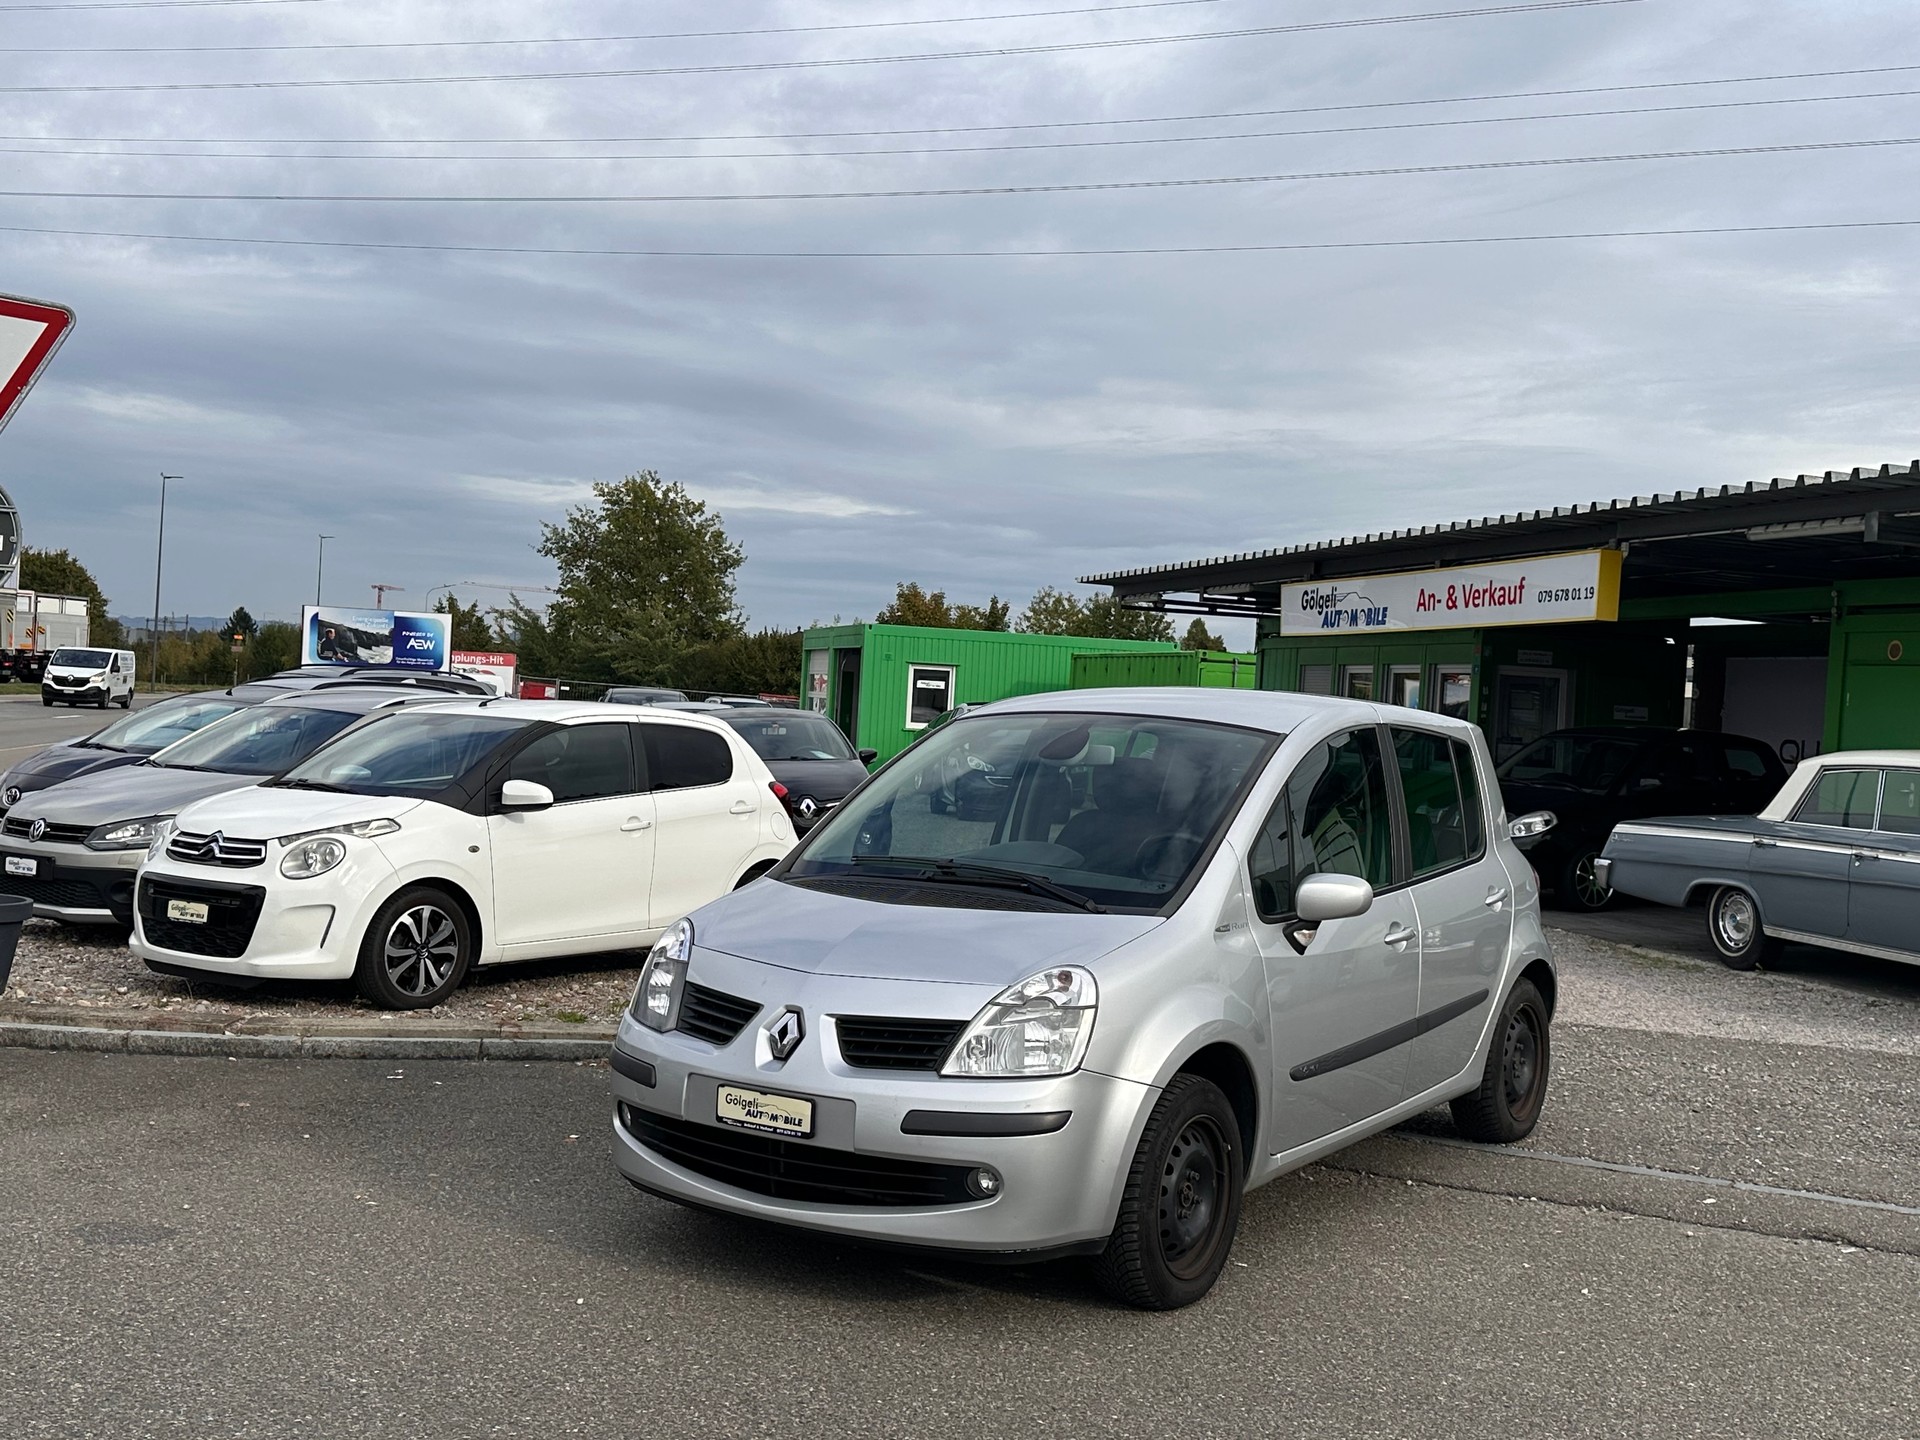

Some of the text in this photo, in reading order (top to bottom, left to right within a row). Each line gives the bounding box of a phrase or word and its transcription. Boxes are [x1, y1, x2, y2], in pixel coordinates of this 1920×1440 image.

[1301, 586, 1337, 615] Gölgeli
[1416, 576, 1595, 612] An- & Verkauf 079 678 01 19
[406, 637, 436, 650] AEW
[725, 1093, 759, 1110] Gölgeli
